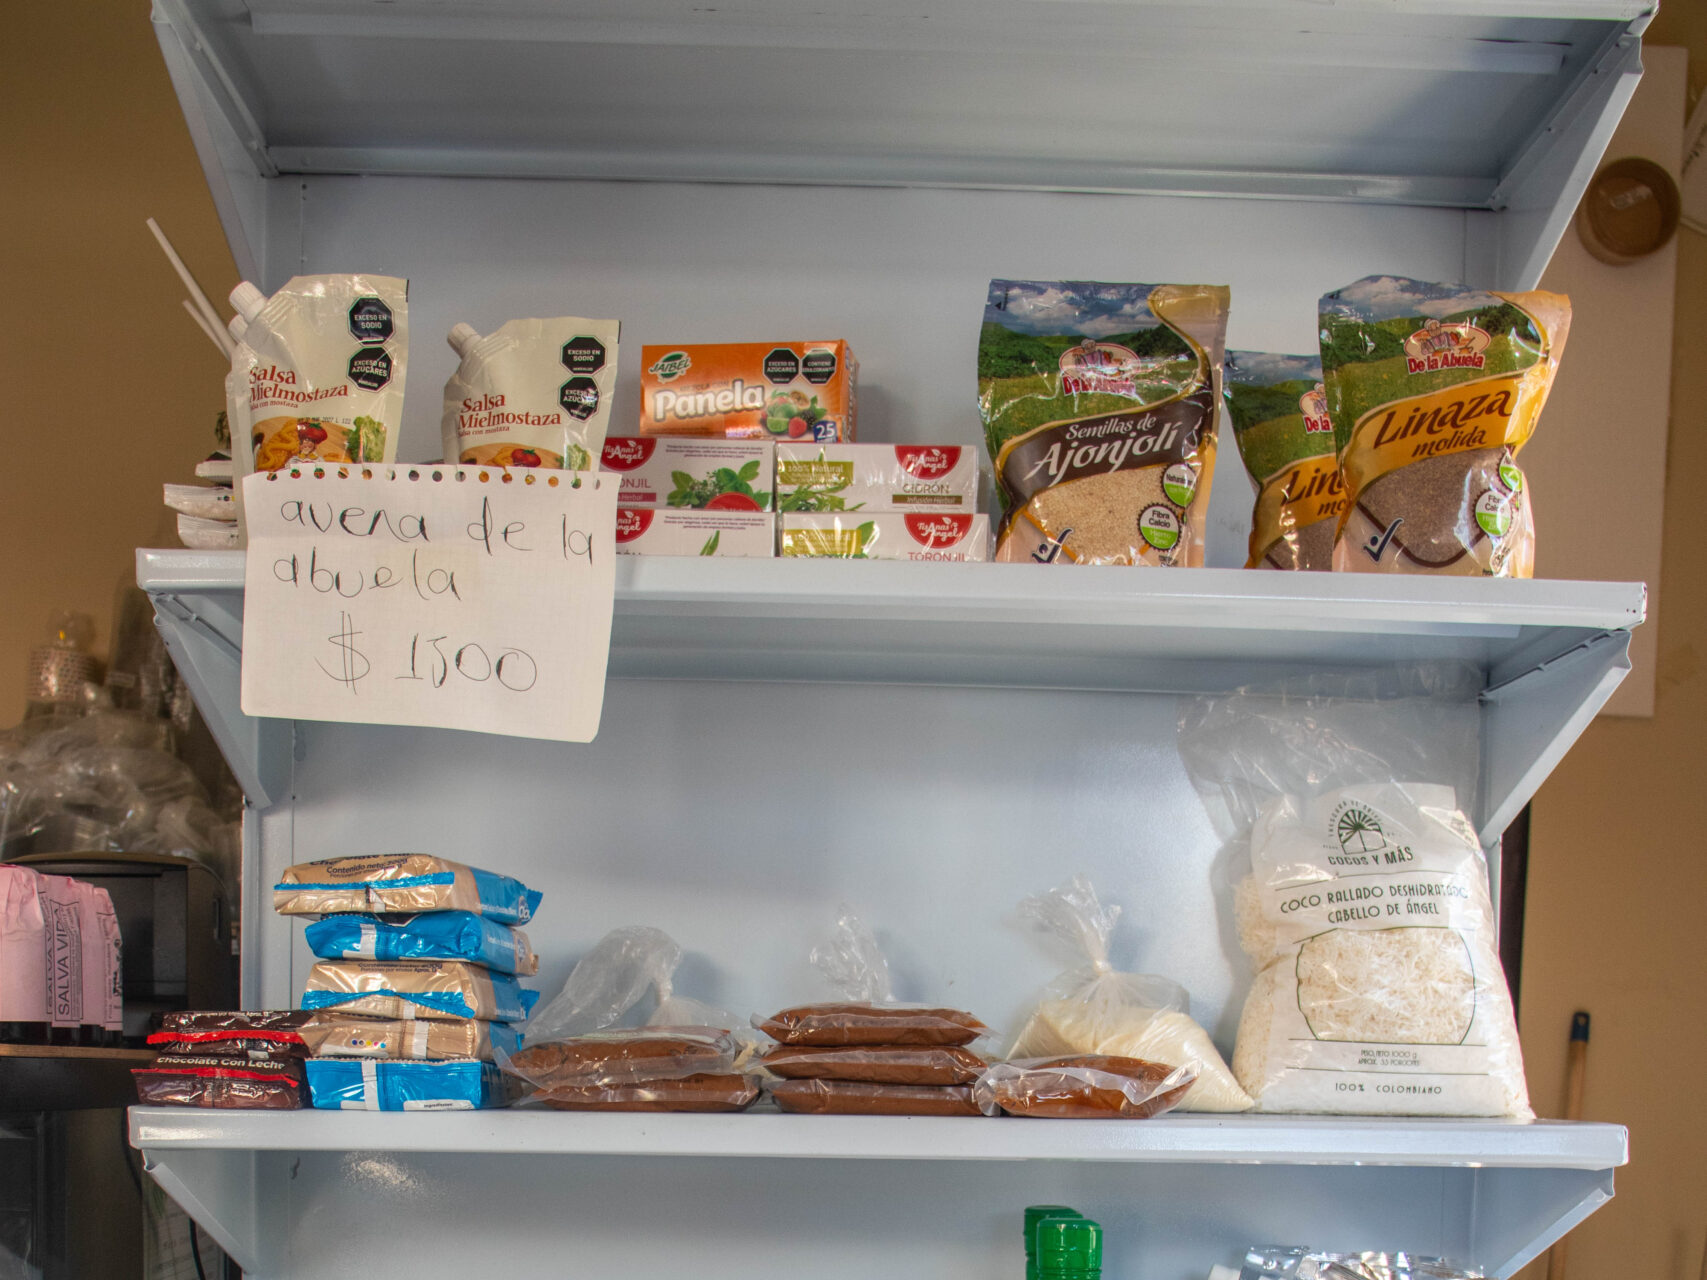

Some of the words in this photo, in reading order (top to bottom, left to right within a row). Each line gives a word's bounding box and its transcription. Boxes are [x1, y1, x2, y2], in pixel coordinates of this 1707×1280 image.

[649, 357, 692, 373] JAIBEL
[1406, 356, 1424, 374] De
[1424, 356, 1438, 371] la
[1440, 352, 1484, 371] Abuela
[249, 365, 296, 385] Salsa
[460, 393, 506, 414] Salsa
[654, 378, 766, 423] Panela
[458, 411, 561, 430] Mielmostaza
[1065, 417, 1134, 440] Semillas
[1136, 413, 1158, 430] de
[1305, 417, 1320, 432] De
[1320, 417, 1330, 432] la
[1372, 389, 1513, 450] Linaza
[816, 422, 836, 439] 25
[1412, 426, 1487, 458] molida
[1022, 421, 1182, 488] Ajonjolí
[812, 464, 844, 474] Natural
[902, 482, 950, 494] CIDRÓN
[1148, 518, 1170, 528] Calcio
[1152, 510, 1170, 519] Fibra
[280, 499, 430, 543] avena
[466, 495, 534, 556] de
[562, 513, 594, 566] la
[274, 546, 462, 601] abuela
[314, 610, 371, 696] $
[394, 632, 538, 692] 1500
[1328, 856, 1369, 866] COCOS
[1372, 854, 1380, 865] Y
[1384, 846, 1414, 864] MÁS
[1280, 894, 1321, 914] COCO
[1327, 885, 1384, 904] RALLADO
[1327, 905, 1380, 924] CABELLO
[1386, 903, 1400, 916] DE
[1406, 898, 1440, 915] ÁNGEL
[57, 956, 70, 1016] SALVA
[220, 1060, 246, 1068] Con
[248, 1060, 286, 1070] Leche
[1336, 1082, 1365, 1092] 100%
[1376, 1085, 1442, 1094] COLOMBIANO
